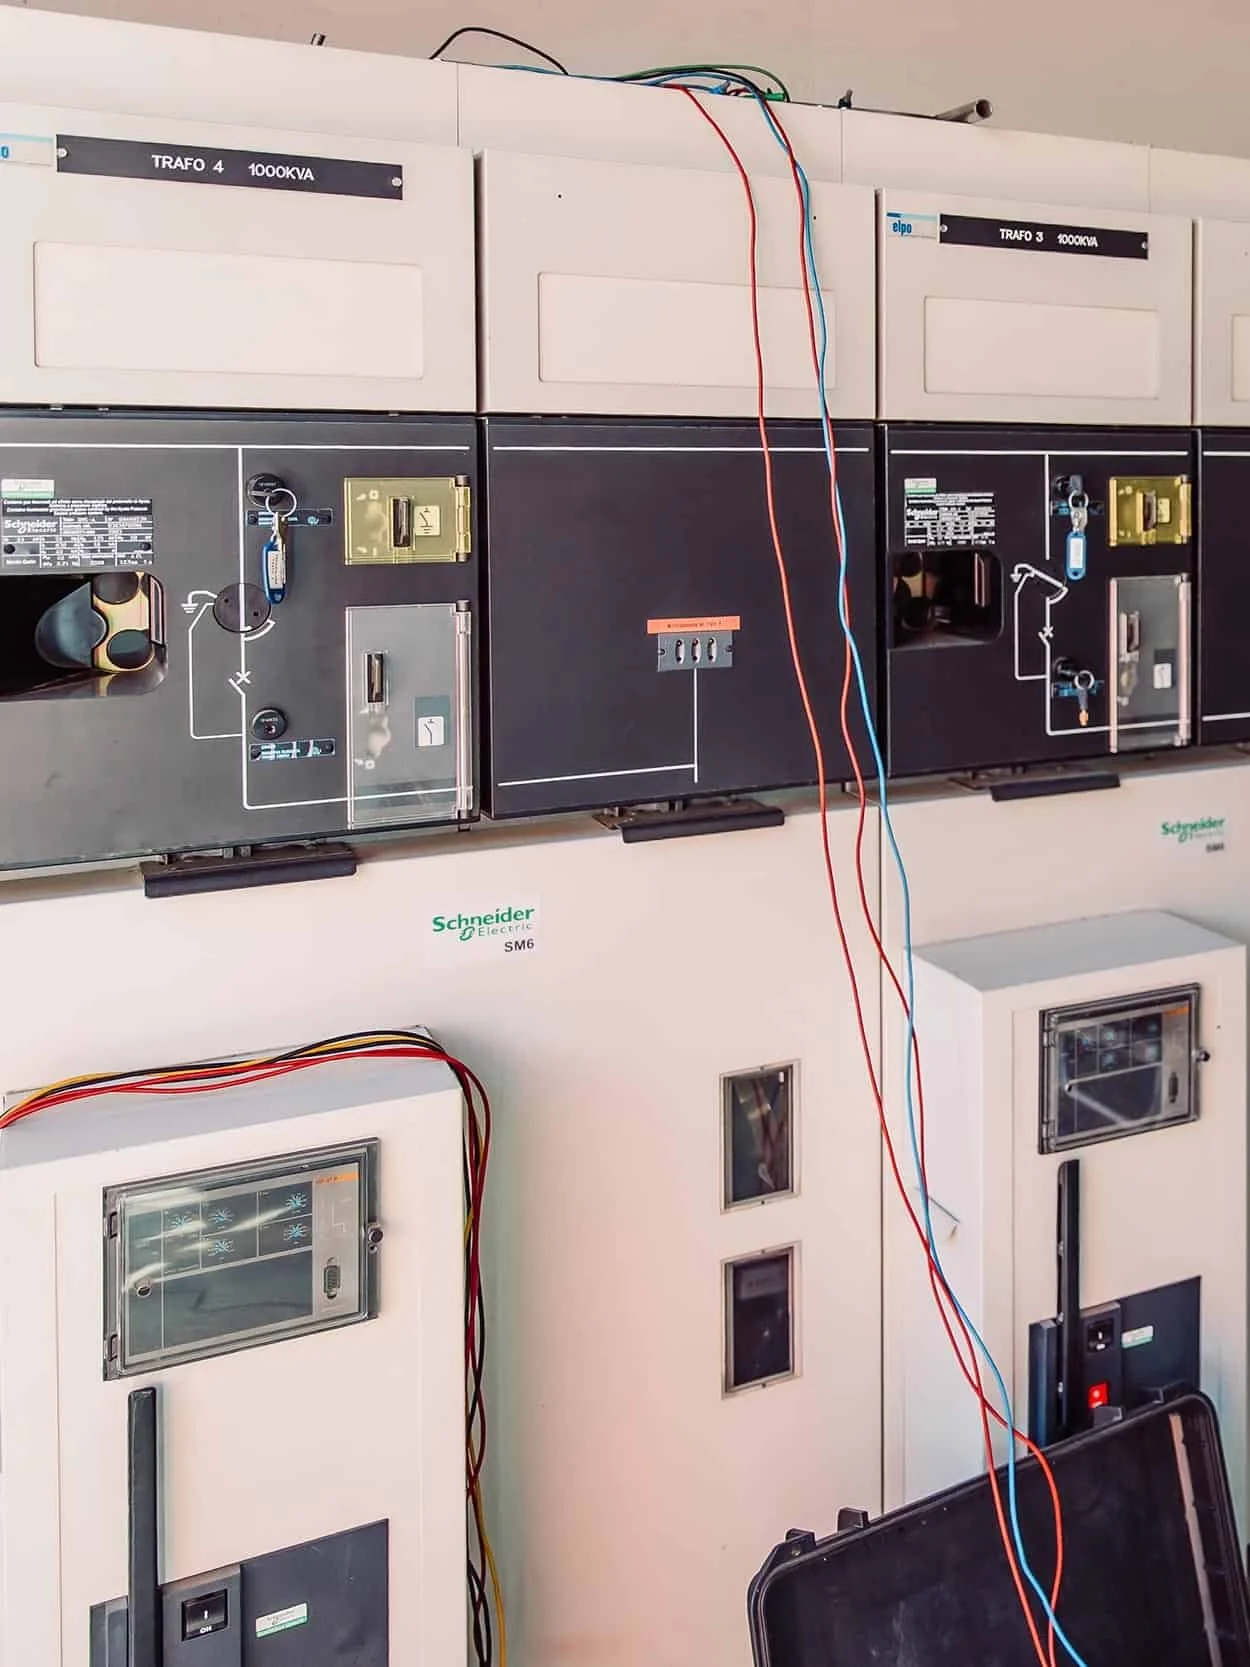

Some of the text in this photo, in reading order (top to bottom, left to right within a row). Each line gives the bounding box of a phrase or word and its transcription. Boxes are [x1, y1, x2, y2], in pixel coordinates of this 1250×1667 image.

[151, 154, 315, 181] TRAFO 4 1000KVA
[892, 220, 912, 236] elpo
[1000, 228, 1099, 247] TRAFO 3 1000KVA
[432, 906, 535, 932] Schneider
[478, 922, 533, 936] Electric
[504, 938, 535, 952] SM6
